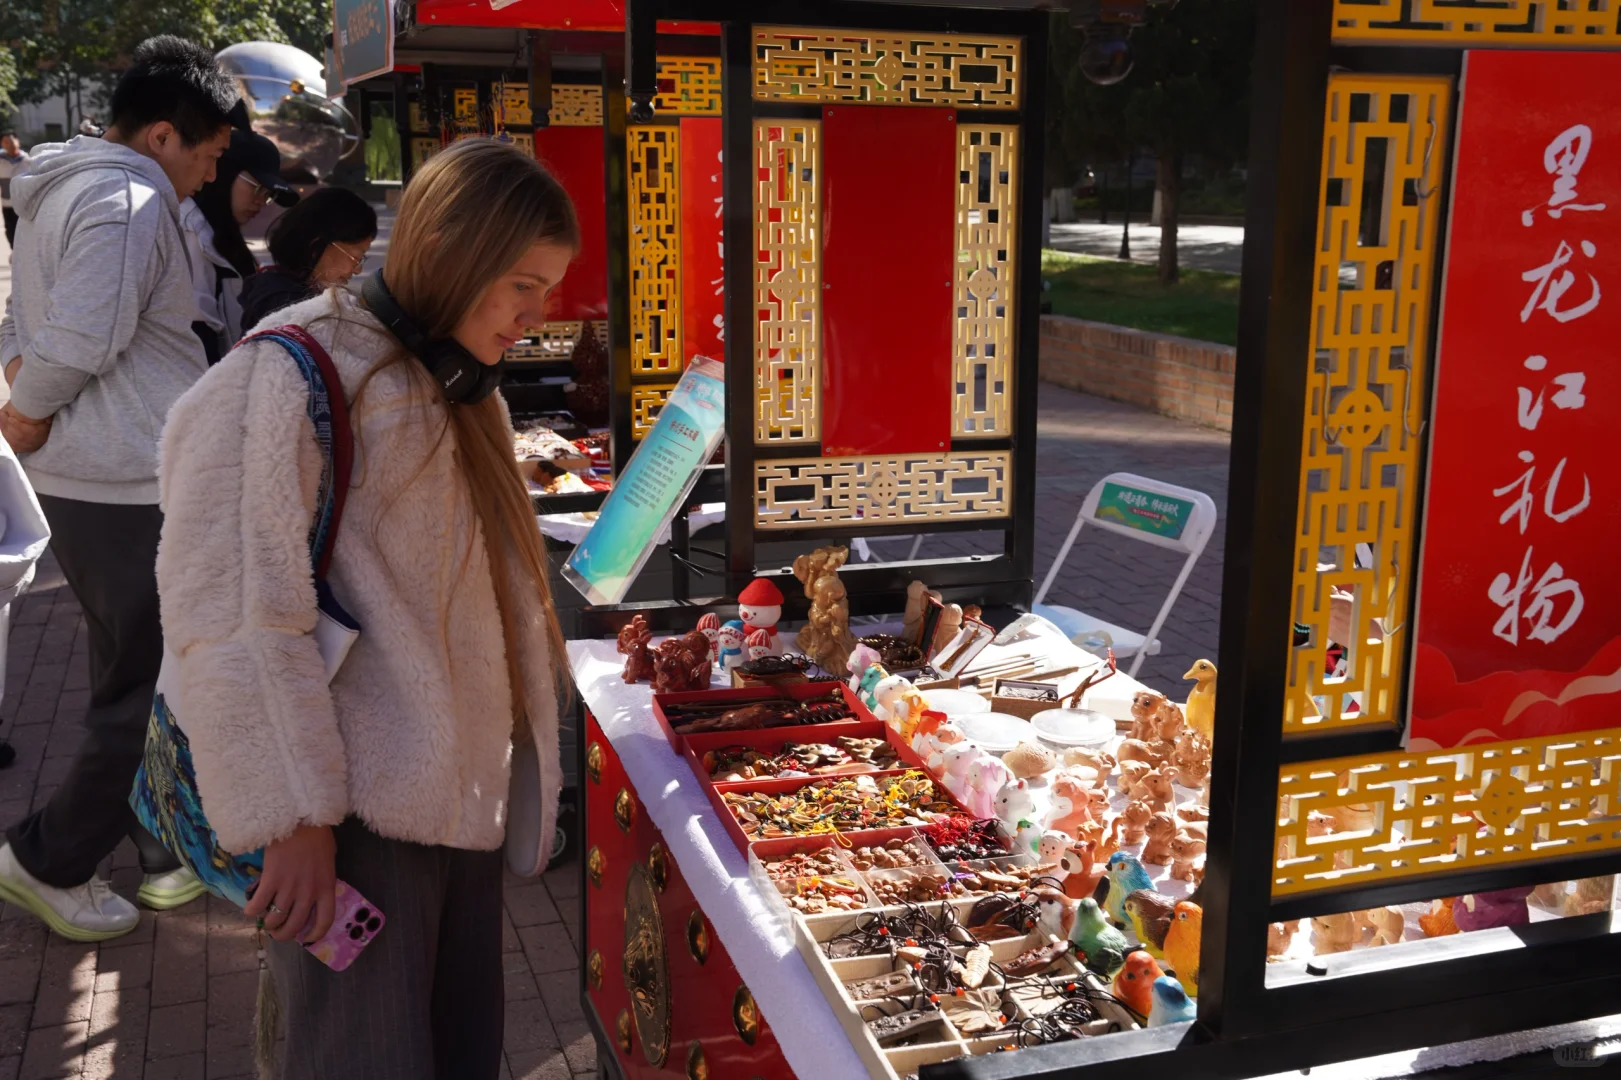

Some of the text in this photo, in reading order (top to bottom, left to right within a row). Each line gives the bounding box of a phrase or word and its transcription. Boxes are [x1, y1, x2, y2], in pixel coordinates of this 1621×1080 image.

[1488, 124, 1606, 646] 黑龙江礼物
